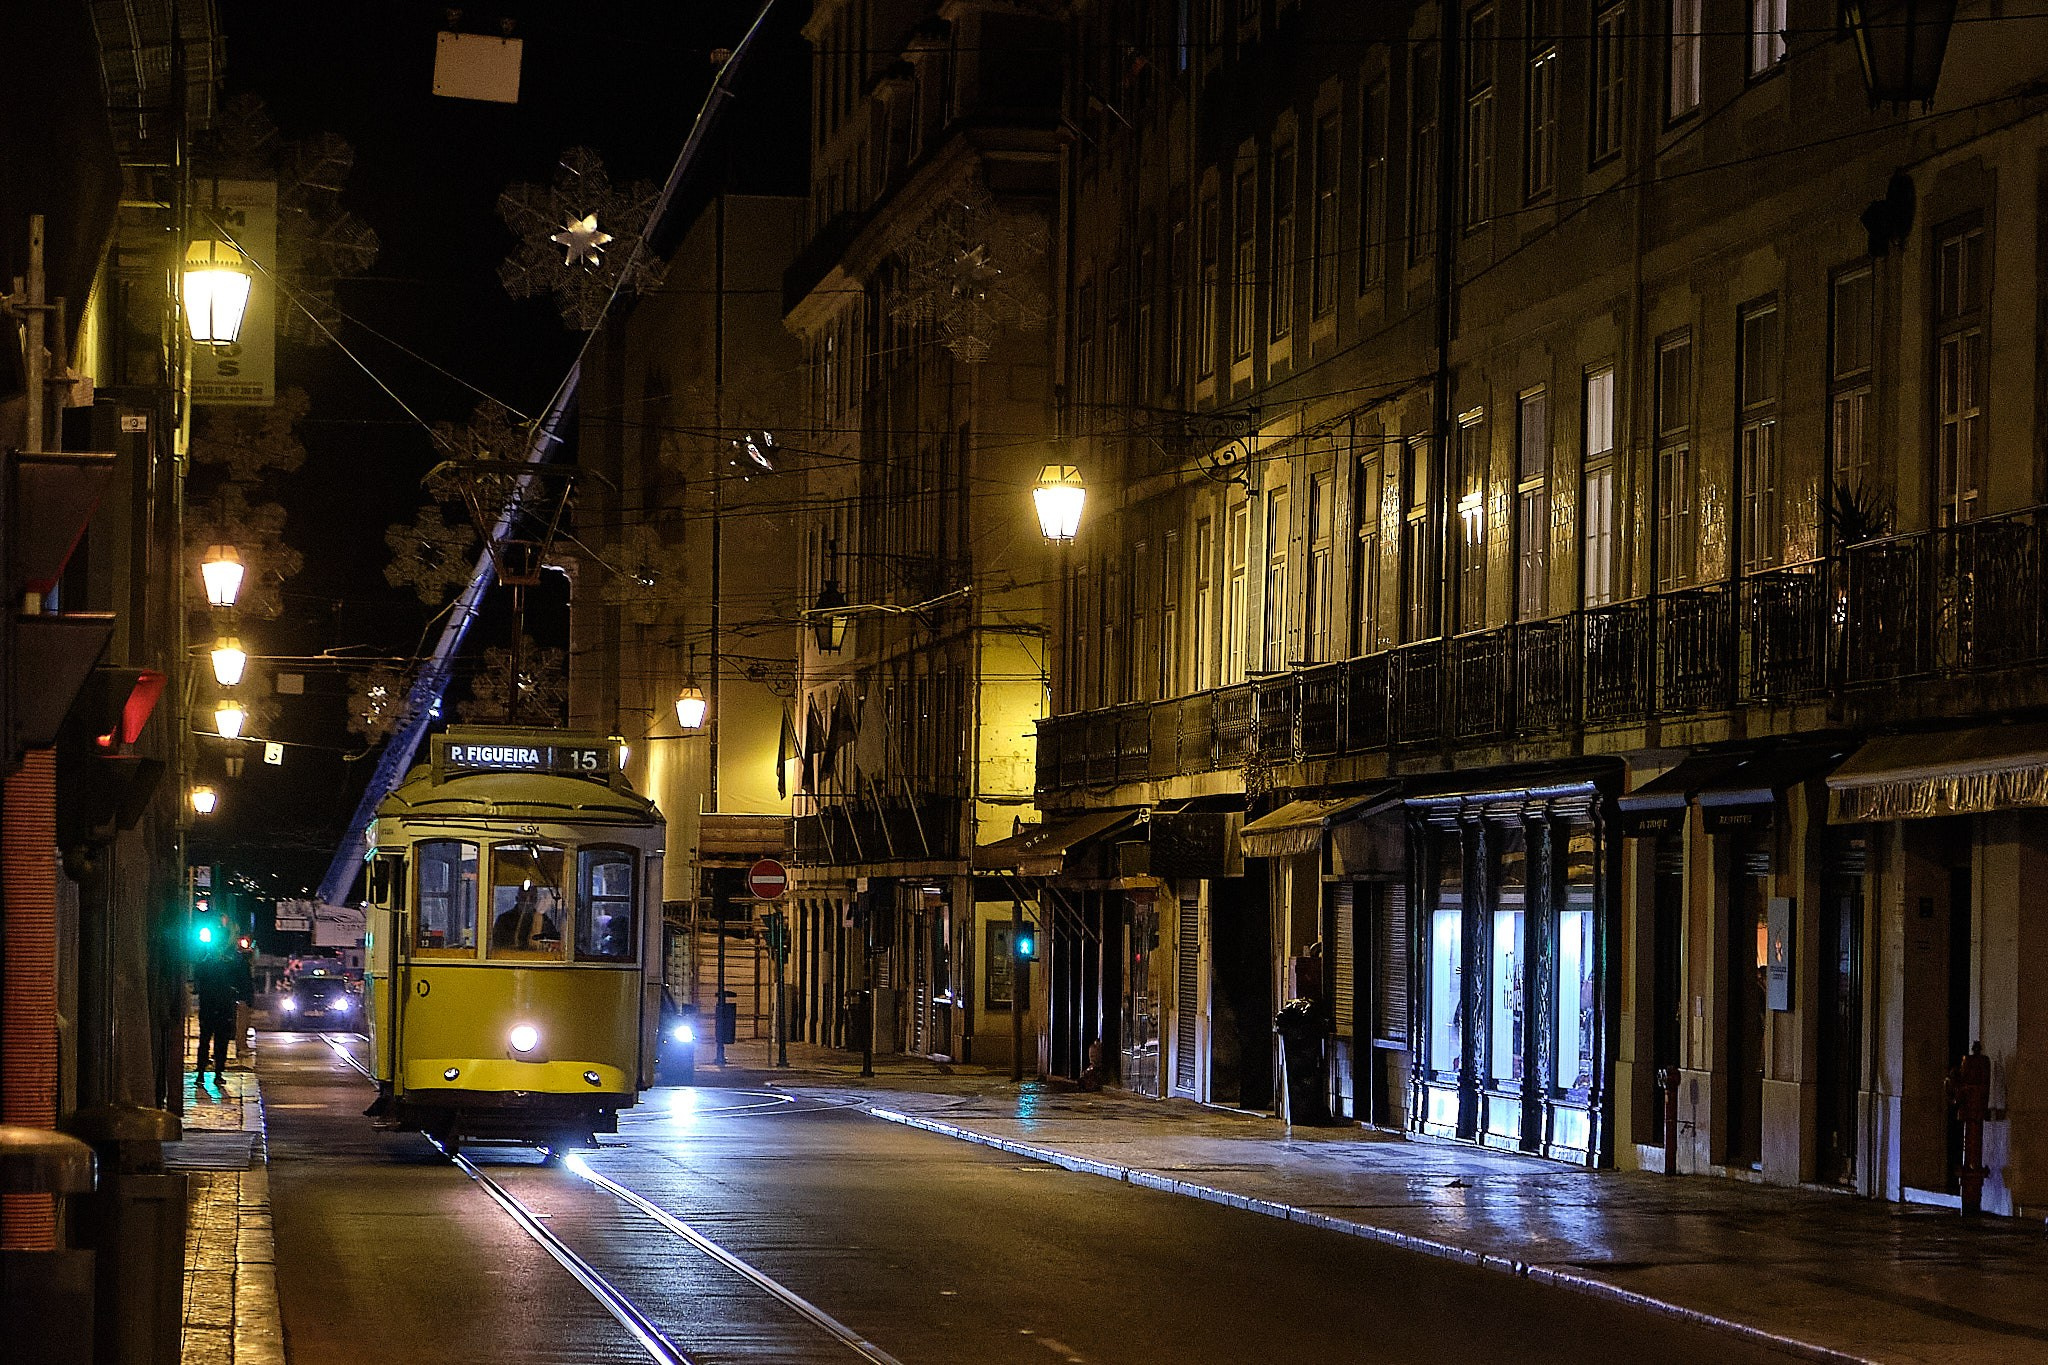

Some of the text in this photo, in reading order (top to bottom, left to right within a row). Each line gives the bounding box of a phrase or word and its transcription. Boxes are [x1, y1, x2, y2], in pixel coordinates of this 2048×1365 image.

[451, 746, 540, 763] P. FIGUEIRA
[570, 750, 597, 770] 15
